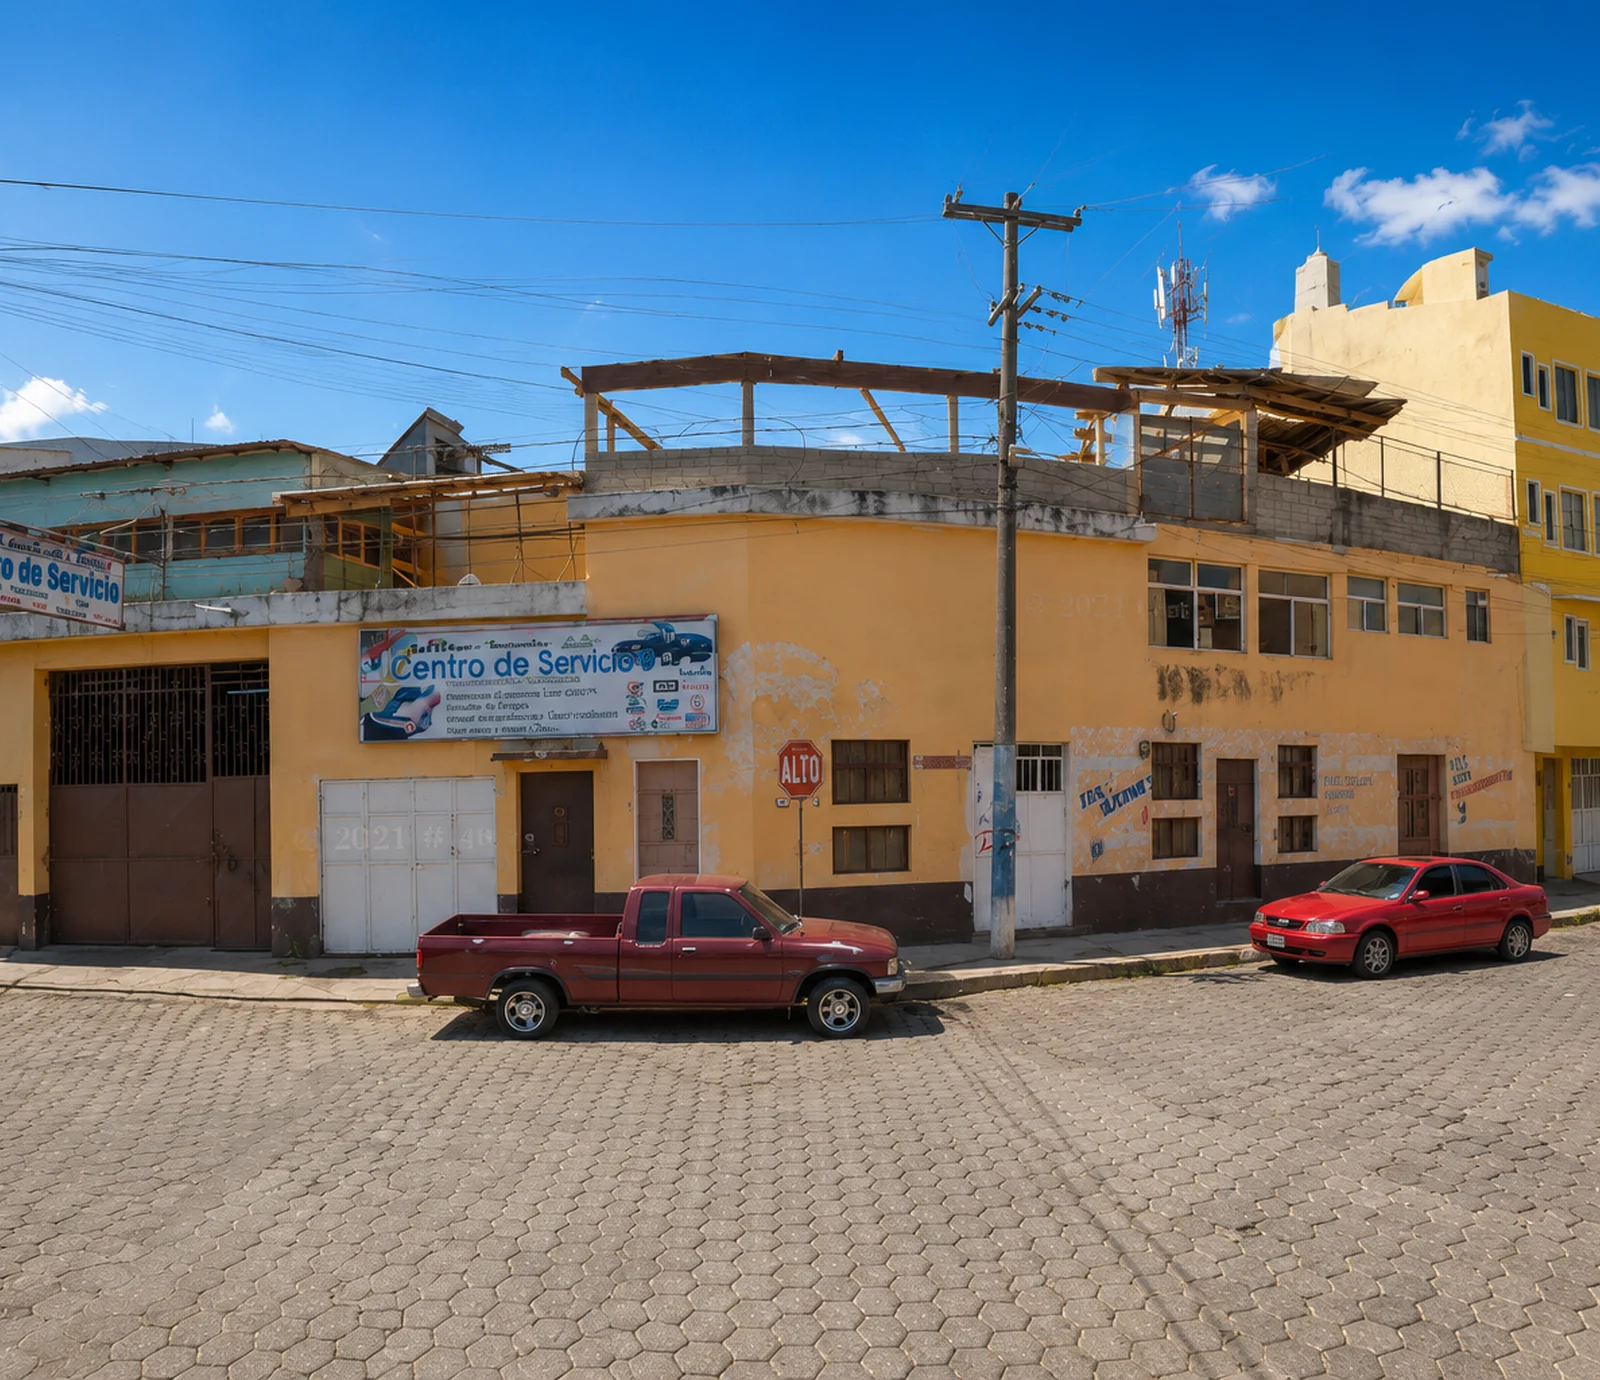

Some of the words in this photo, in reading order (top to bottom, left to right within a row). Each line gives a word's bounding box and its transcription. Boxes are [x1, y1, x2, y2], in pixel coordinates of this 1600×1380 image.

[0, 557, 14, 580] o
[18, 557, 42, 587] de
[47, 562, 119, 604] Servicio
[391, 653, 485, 680] Centro
[494, 651, 529, 680] de
[538, 648, 635, 676] Servicio
[781, 754, 819, 783] ALTO
